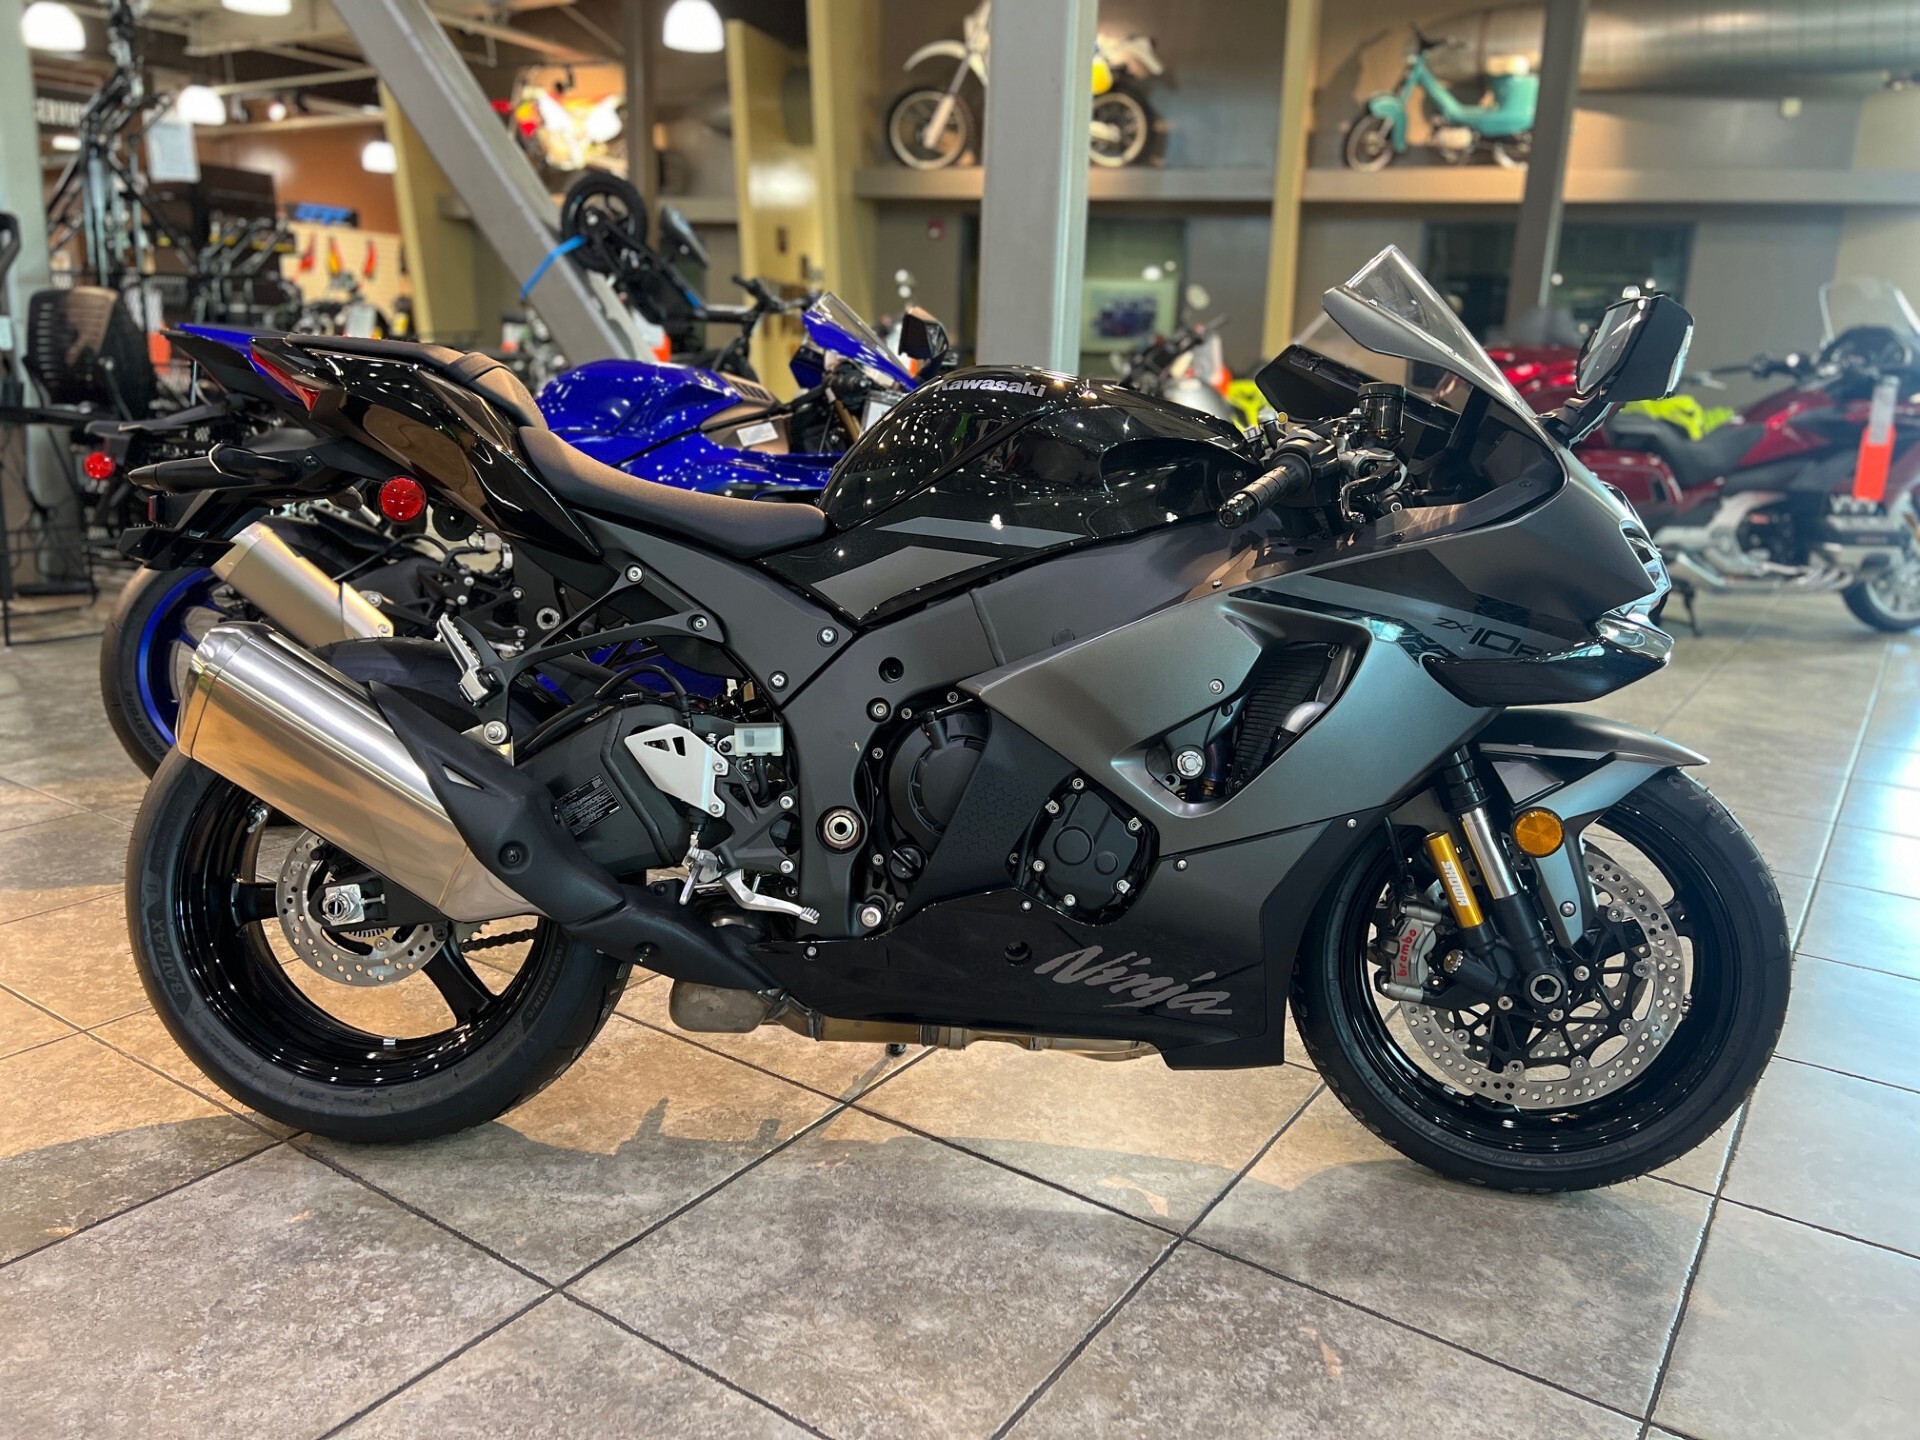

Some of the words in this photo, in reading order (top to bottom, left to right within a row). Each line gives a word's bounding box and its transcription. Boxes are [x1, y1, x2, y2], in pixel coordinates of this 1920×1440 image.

[934, 379, 1047, 398] Kawasaki
[1441, 861, 1470, 906] SHOWA
[1397, 929, 1417, 977] brembo
[1034, 945, 1233, 1015] Ninja
